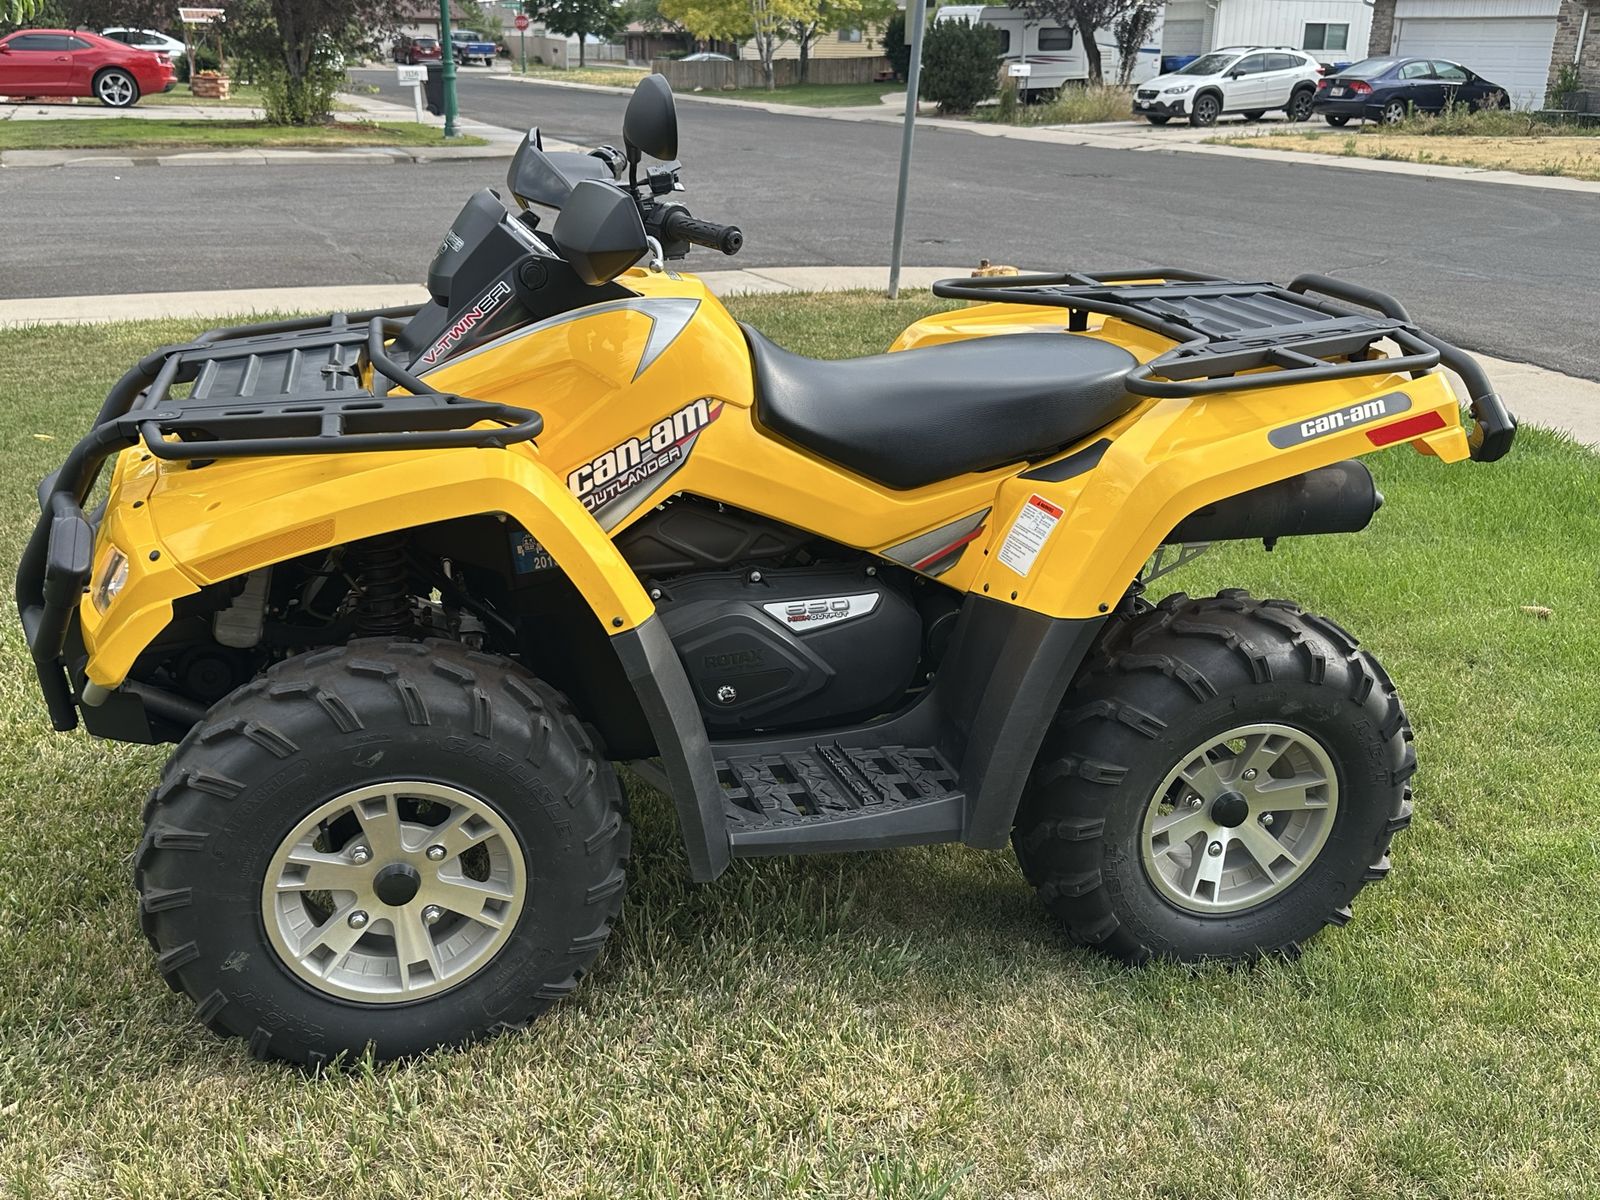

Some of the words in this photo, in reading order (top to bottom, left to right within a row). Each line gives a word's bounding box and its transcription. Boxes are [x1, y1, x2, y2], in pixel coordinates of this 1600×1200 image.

[1300, 399, 1386, 438] can-am
[567, 397, 709, 498] can-am
[582, 445, 682, 512] OUTLANDER
[785, 598, 849, 616] 650
